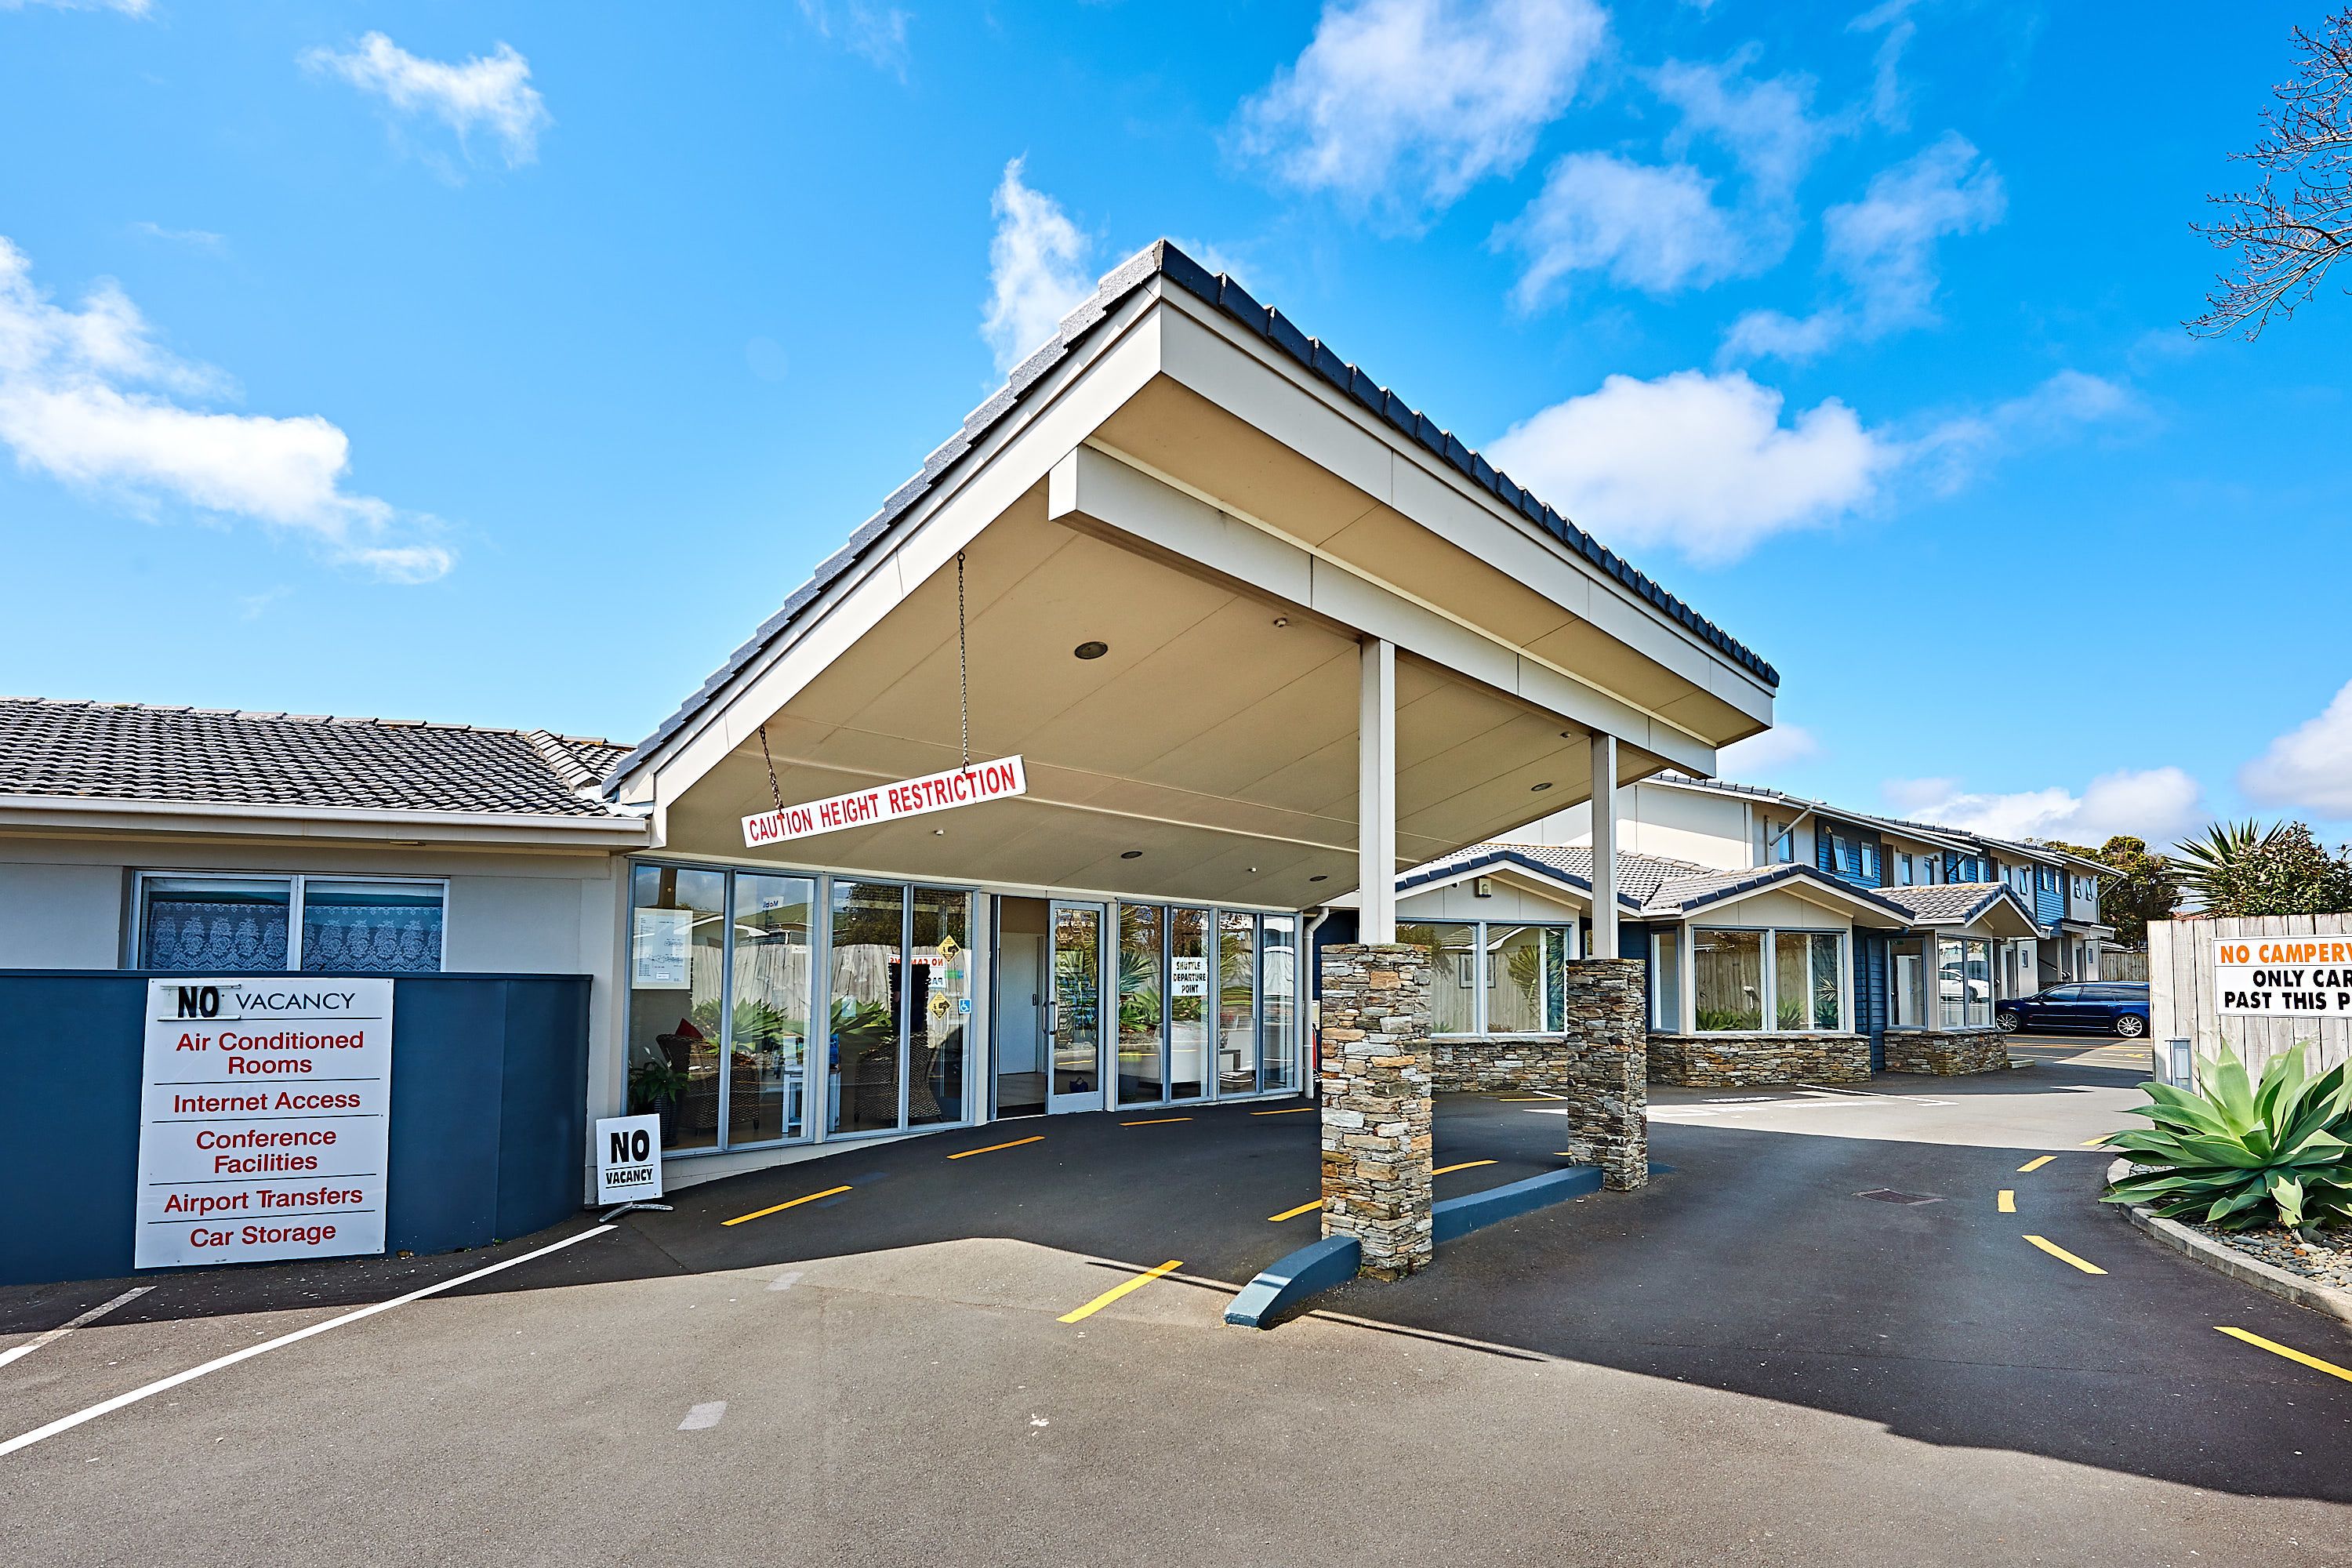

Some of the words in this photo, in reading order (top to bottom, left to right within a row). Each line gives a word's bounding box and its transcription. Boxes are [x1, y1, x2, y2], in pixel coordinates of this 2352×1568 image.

[749, 808, 814, 841] CAUTION
[820, 793, 879, 829] HEIGHT
[888, 763, 1016, 814] RESTRICTION
[2220, 945, 2250, 964] NO
[1176, 961, 1200, 970] SHUTTLE
[1181, 984, 1198, 993] POINT
[2252, 970, 2305, 987] ONLY
[2313, 969, 2352, 988] CAR
[177, 985, 220, 1018] NO
[235, 993, 356, 1011] VACANCY
[2224, 991, 2272, 1009] PAST
[2281, 992, 2327, 1011] THIS
[176, 1033, 211, 1051] Air
[219, 1031, 364, 1051] Conditioned
[228, 1056, 312, 1074] Rooms
[174, 1093, 267, 1112] Internet
[274, 1091, 361, 1110] Access
[196, 1129, 336, 1149] Conference
[610, 1129, 650, 1163] NO
[214, 1152, 318, 1174] Facilities
[605, 1168, 653, 1185] VACANCY
[164, 1192, 249, 1215] Airport
[256, 1187, 363, 1208] Transfers
[190, 1228, 234, 1247] Car
[241, 1225, 336, 1245] Storage
